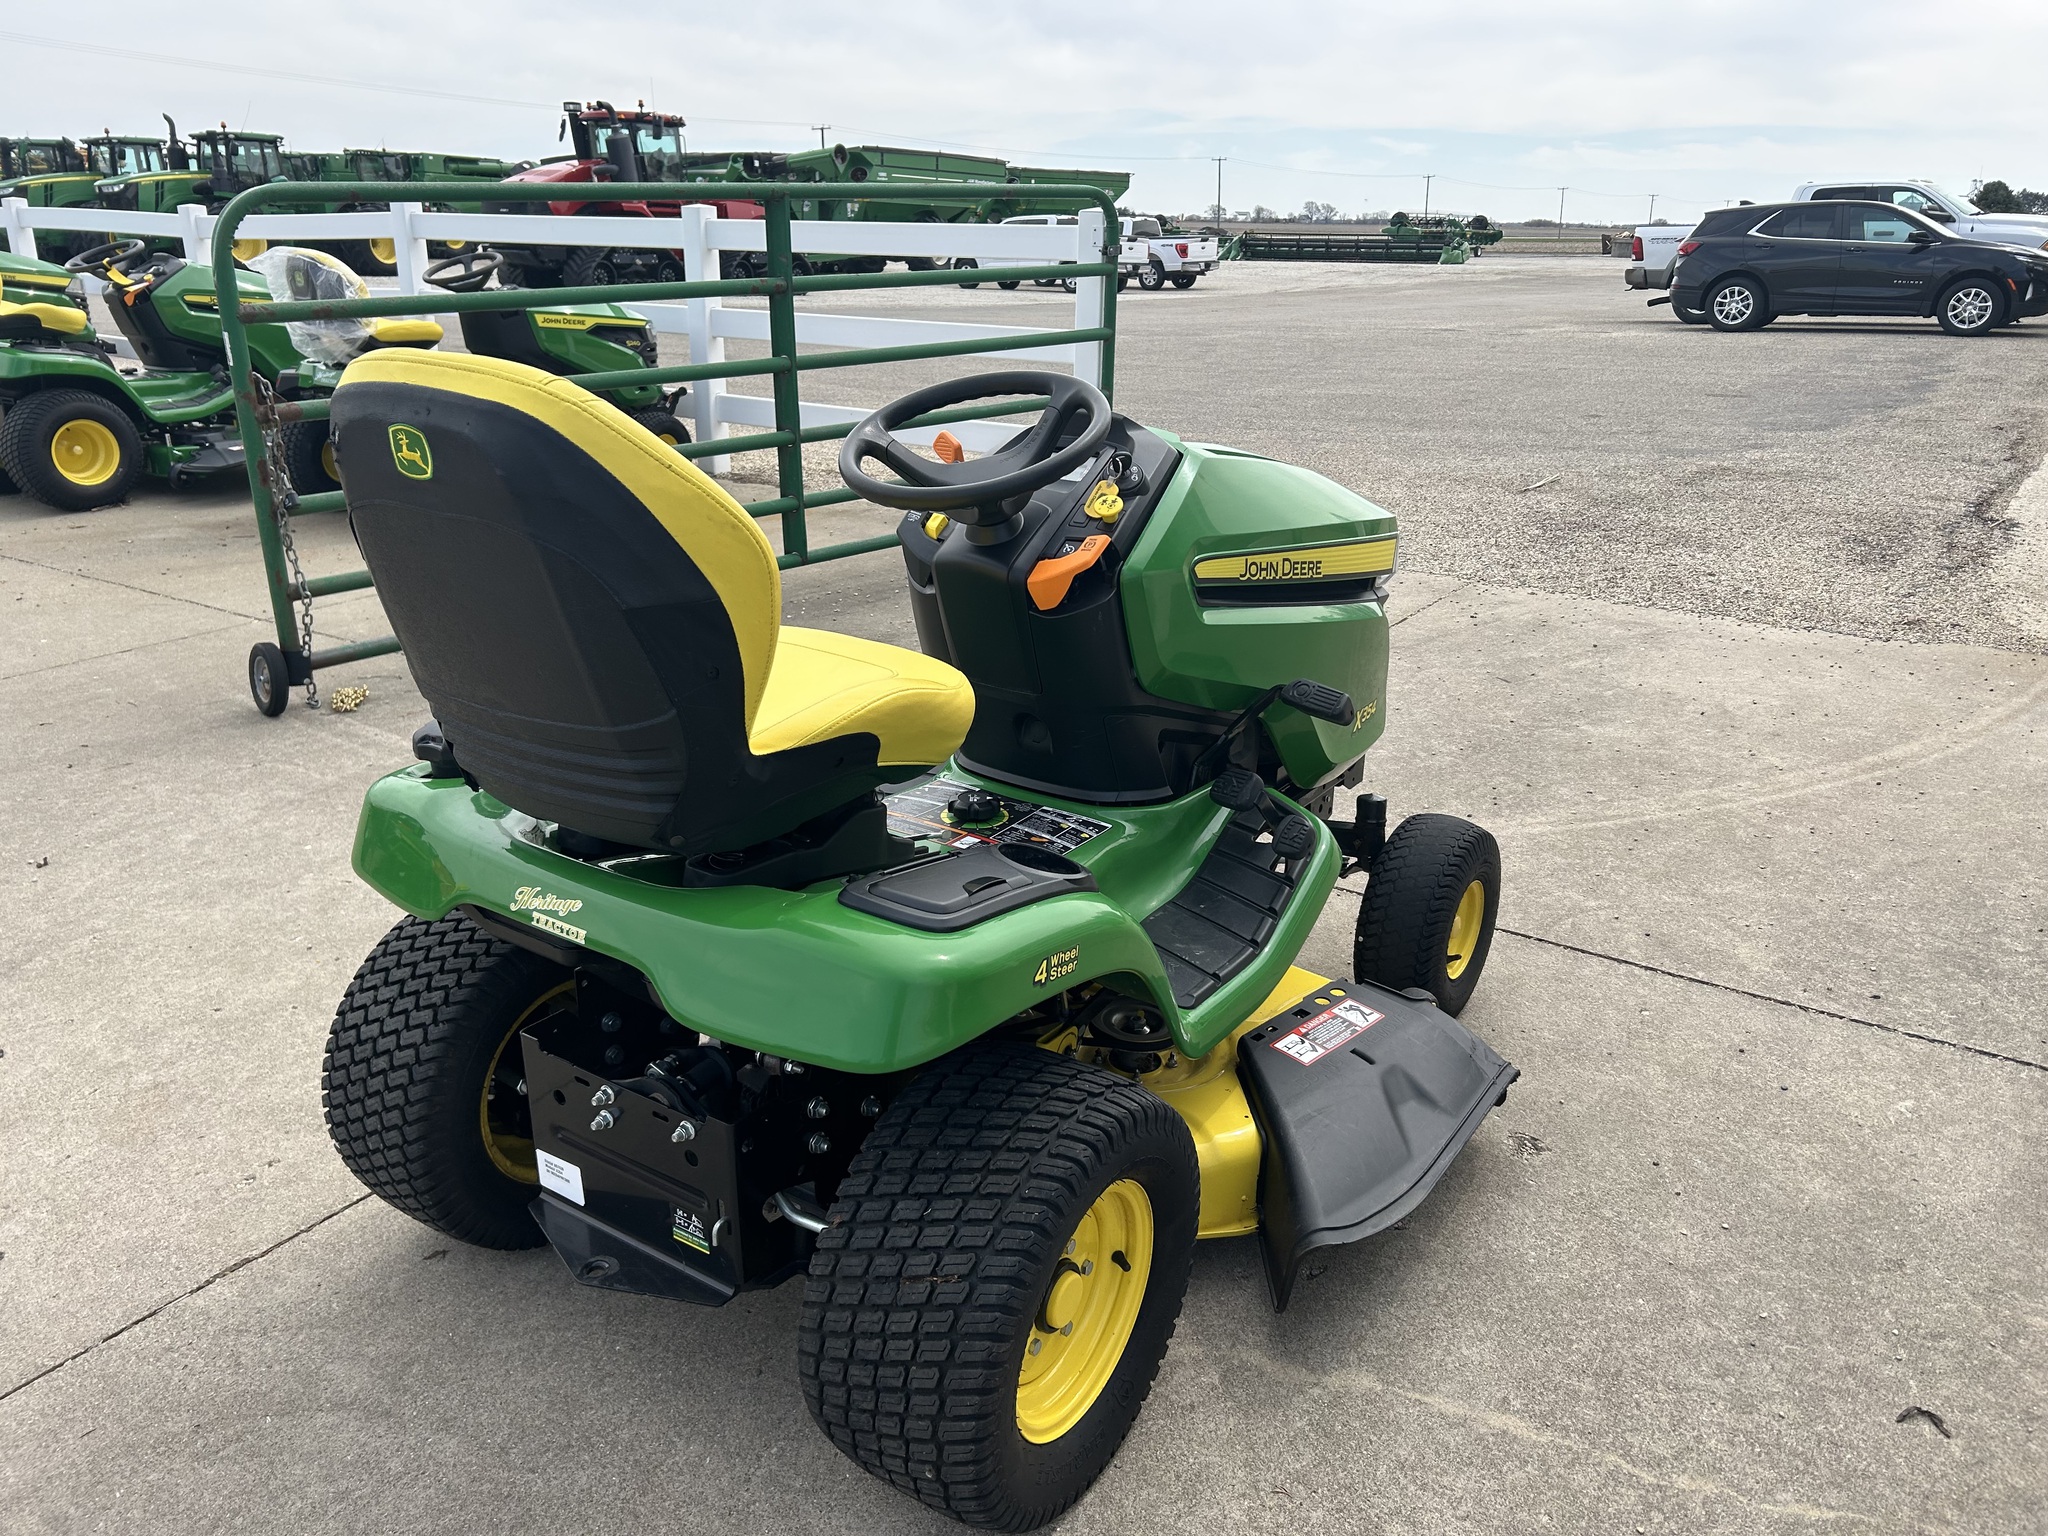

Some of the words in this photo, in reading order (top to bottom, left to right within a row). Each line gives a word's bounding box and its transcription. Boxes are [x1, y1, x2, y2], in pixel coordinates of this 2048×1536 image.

[541, 316, 562, 325] JOHN
[562, 317, 587, 326] DEERE
[1239, 557, 1280, 581] JOHN
[1281, 557, 1324, 579] DEERE
[1353, 698, 1378, 733] X354
[509, 886, 584, 917] Heritage
[531, 911, 588, 945] TRACTOR
[1034, 959, 1048, 984] 4
[1050, 944, 1080, 967] Wheel
[1049, 959, 1079, 981] Steer
[1305, 1013, 1332, 1032] DANGER
